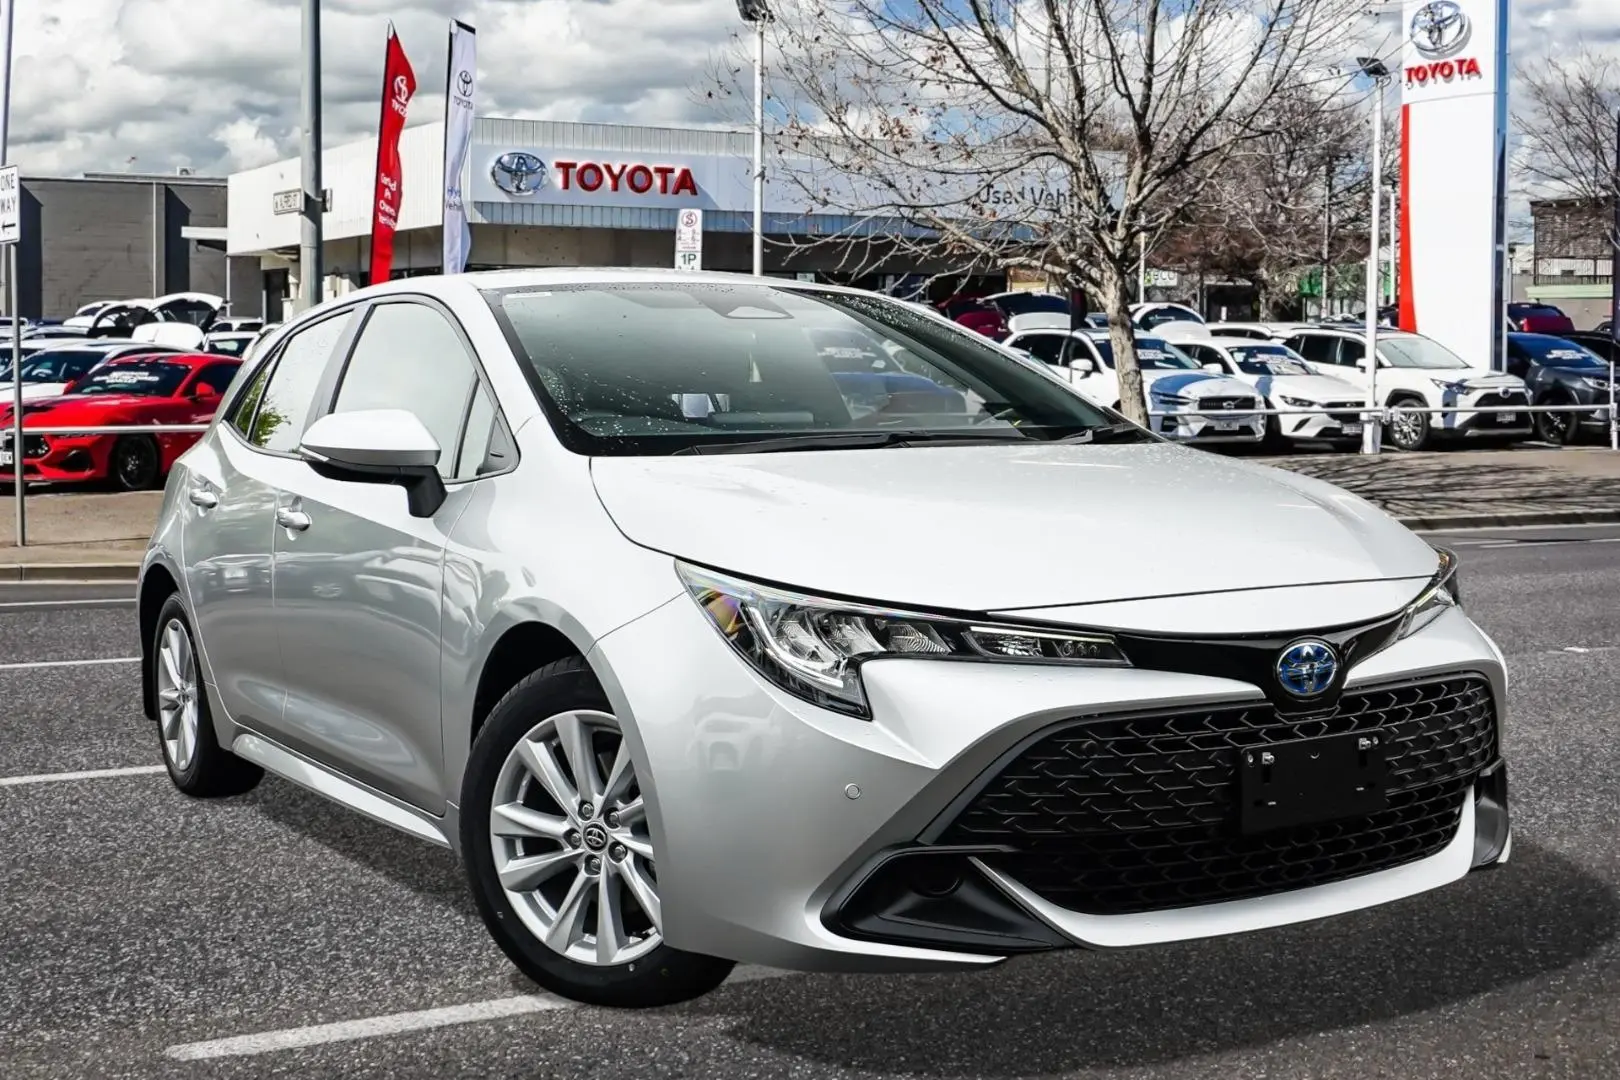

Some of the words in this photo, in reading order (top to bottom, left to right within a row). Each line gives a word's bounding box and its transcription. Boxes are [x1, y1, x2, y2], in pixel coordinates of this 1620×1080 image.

[1404, 58, 1481, 83] TOYOTA
[555, 161, 698, 196] TOYOTA
[680, 253, 697, 265] 1P
